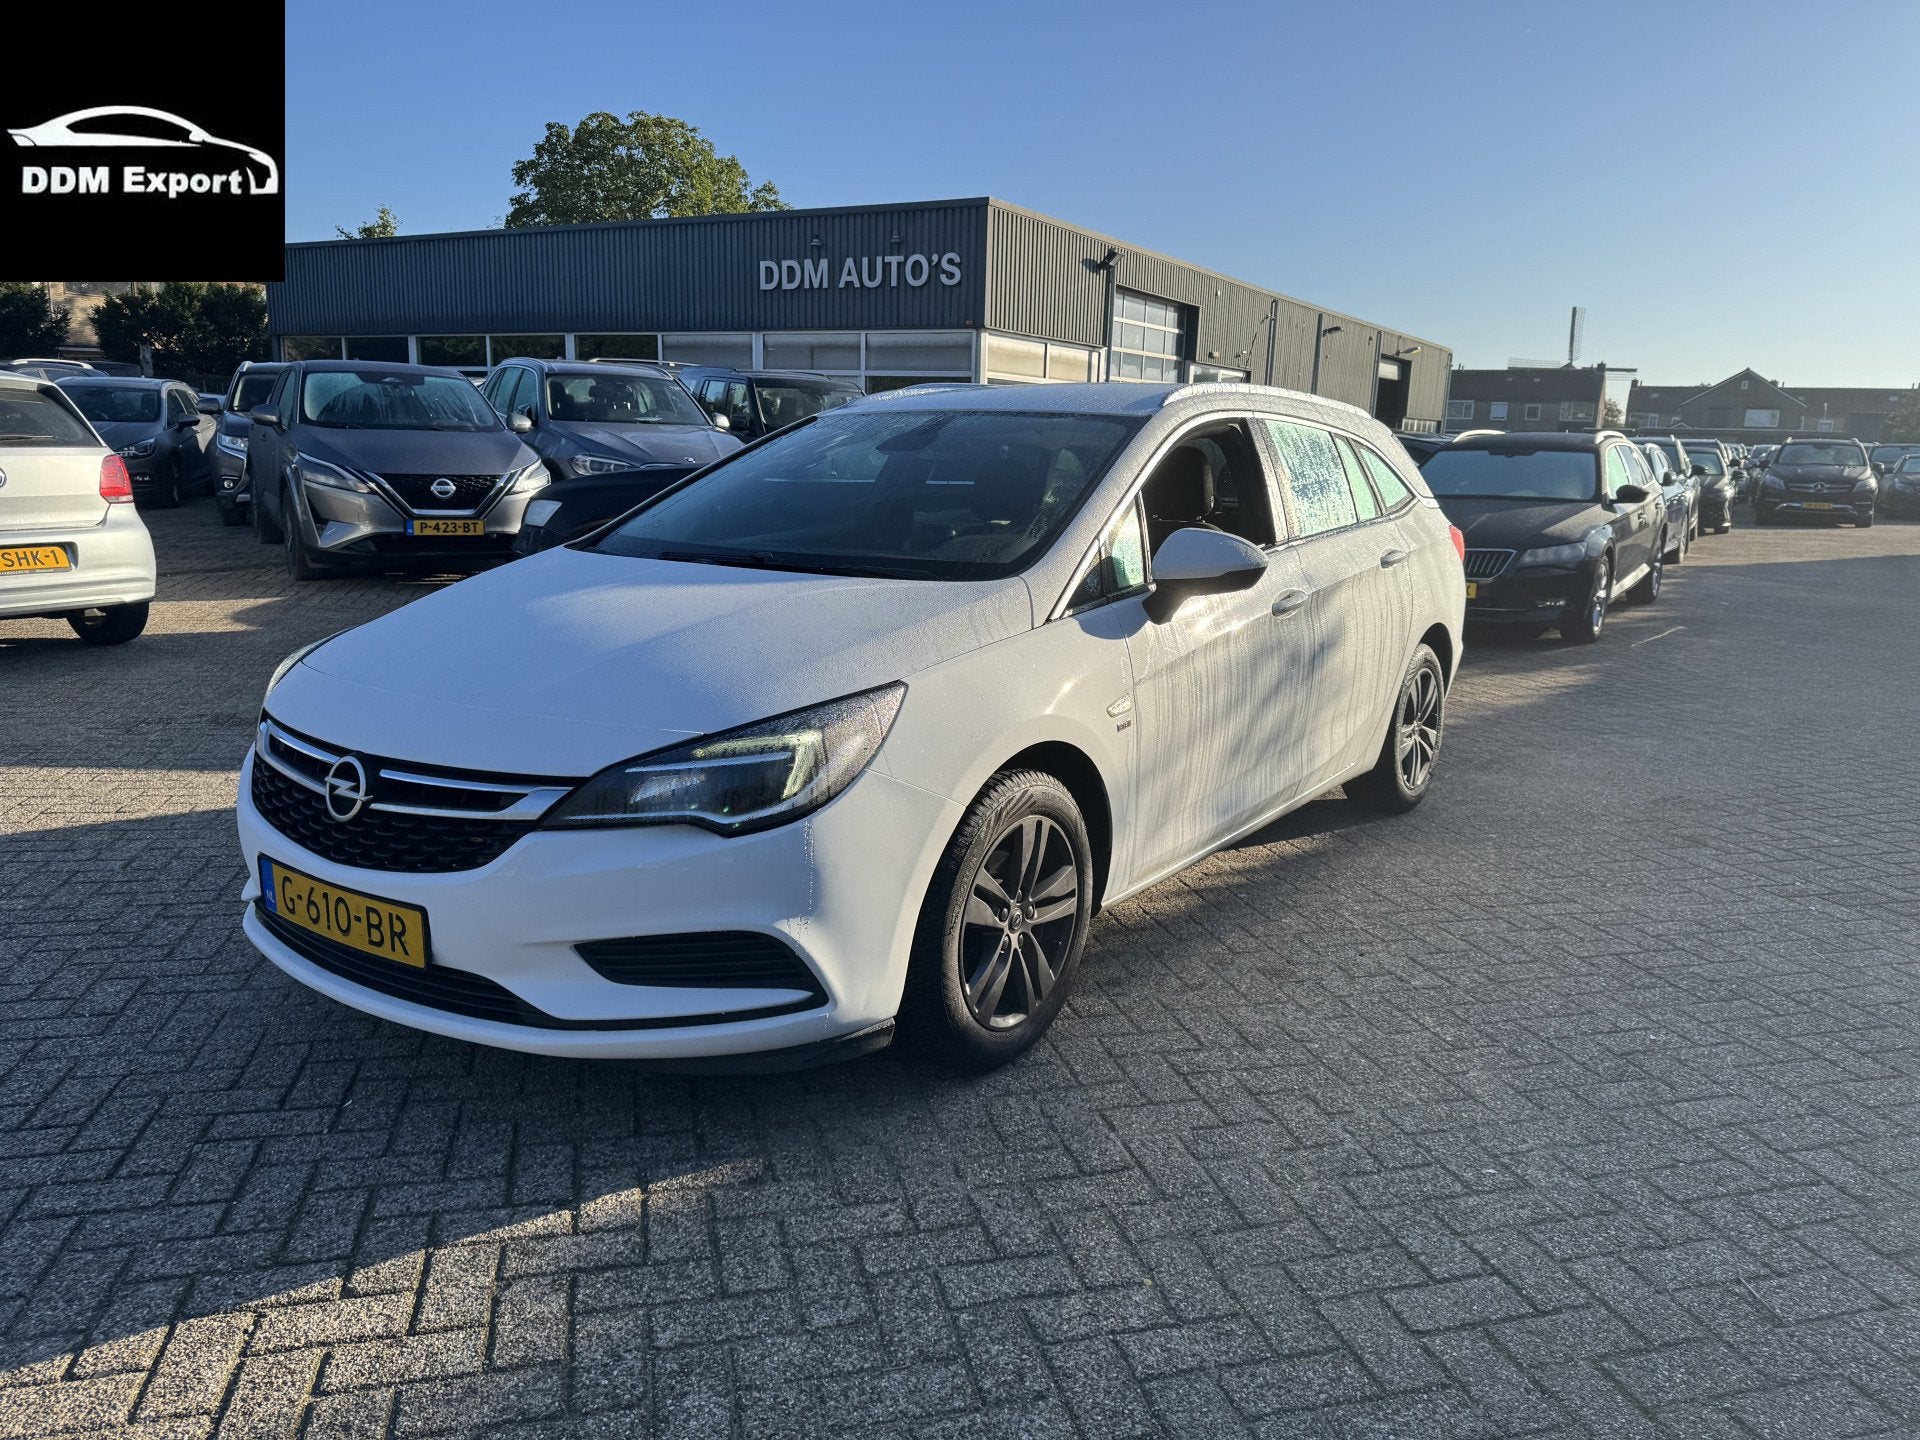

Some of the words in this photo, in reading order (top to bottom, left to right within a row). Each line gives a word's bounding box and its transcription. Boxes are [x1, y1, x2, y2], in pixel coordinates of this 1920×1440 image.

[759, 258, 829, 290] DDM
[838, 252, 962, 289] AUTO'S
[420, 522, 479, 533] P-423-BT
[265, 889, 276, 903] NL
[281, 875, 410, 957] G-610-BR
